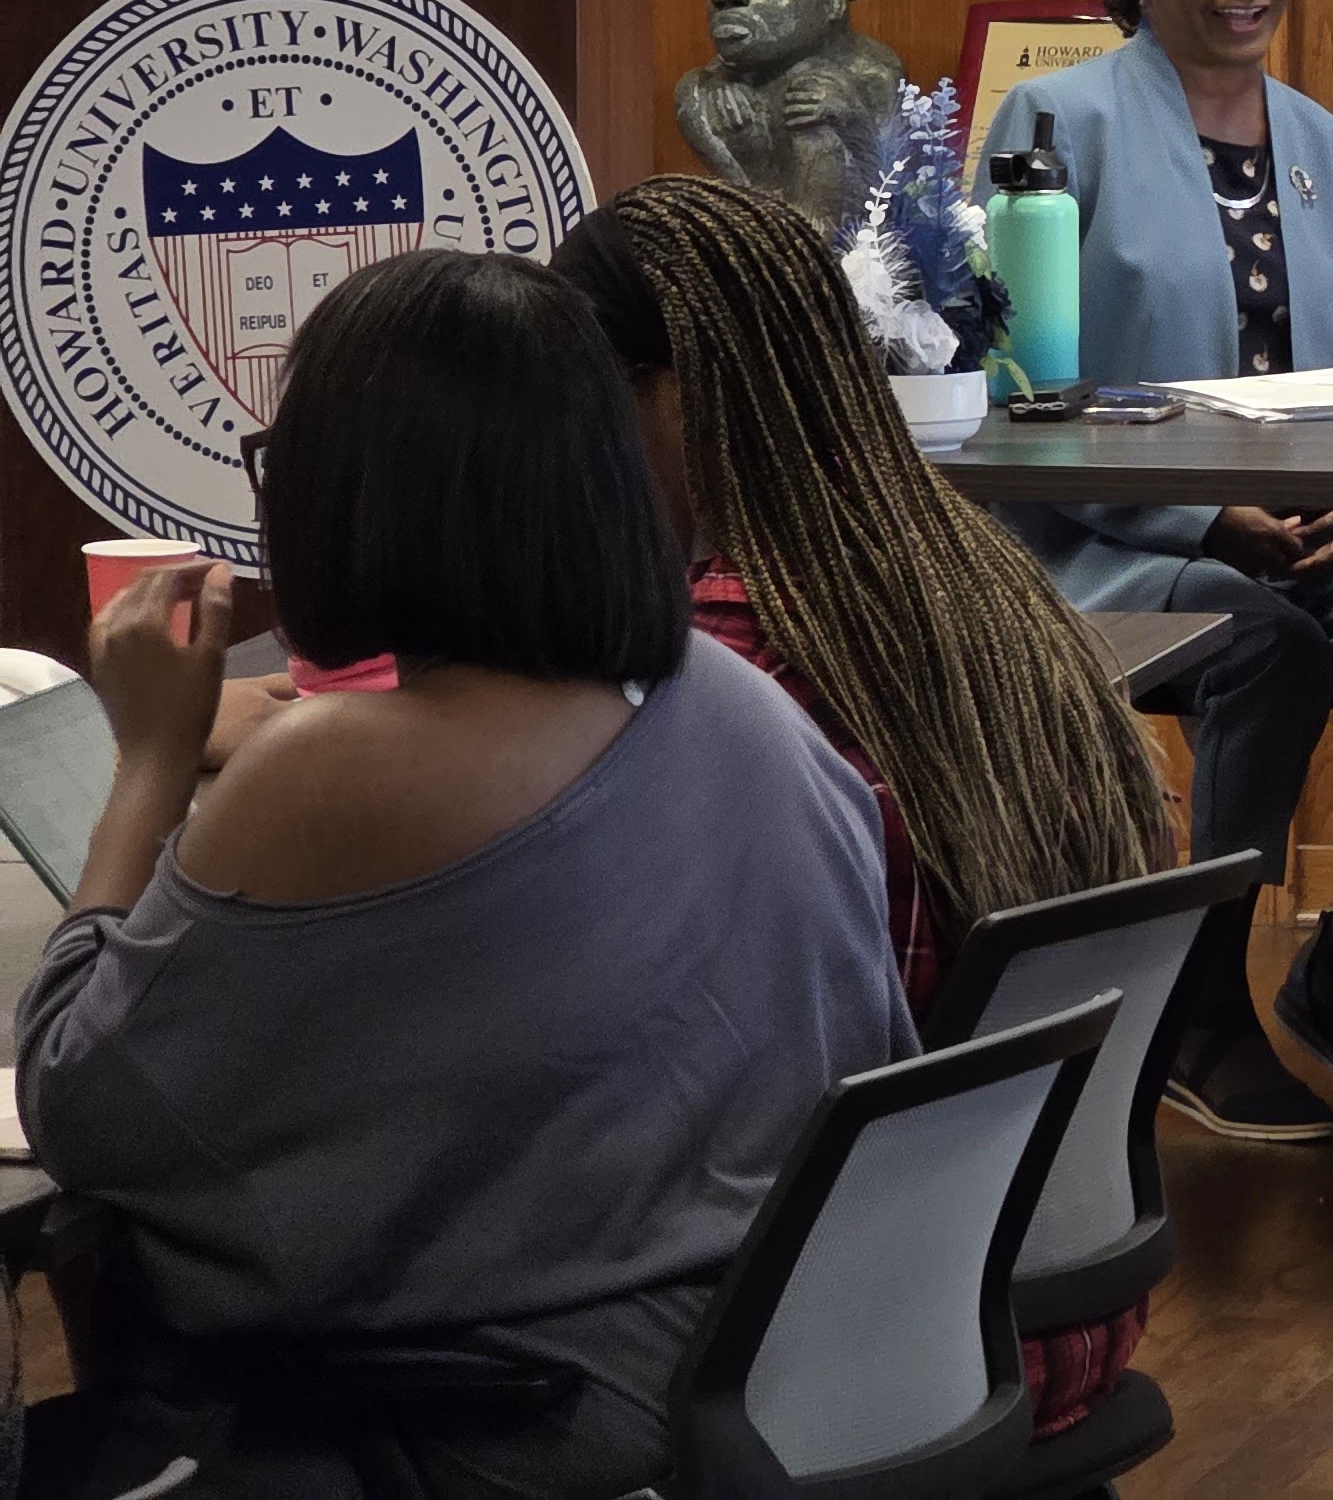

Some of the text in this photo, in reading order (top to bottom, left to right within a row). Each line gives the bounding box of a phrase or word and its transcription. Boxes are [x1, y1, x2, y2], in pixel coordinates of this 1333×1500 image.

[1036, 45, 1103, 58] HOWARD
[1034, 58, 1090, 68] UNIVER
[40, 10, 539, 440] HOWARD UNIVERSITY WASHINGTO
[106, 86, 302, 428] VERITAS ET
[245, 273, 329, 291] DEO ET
[239, 314, 287, 330] REIPUB
